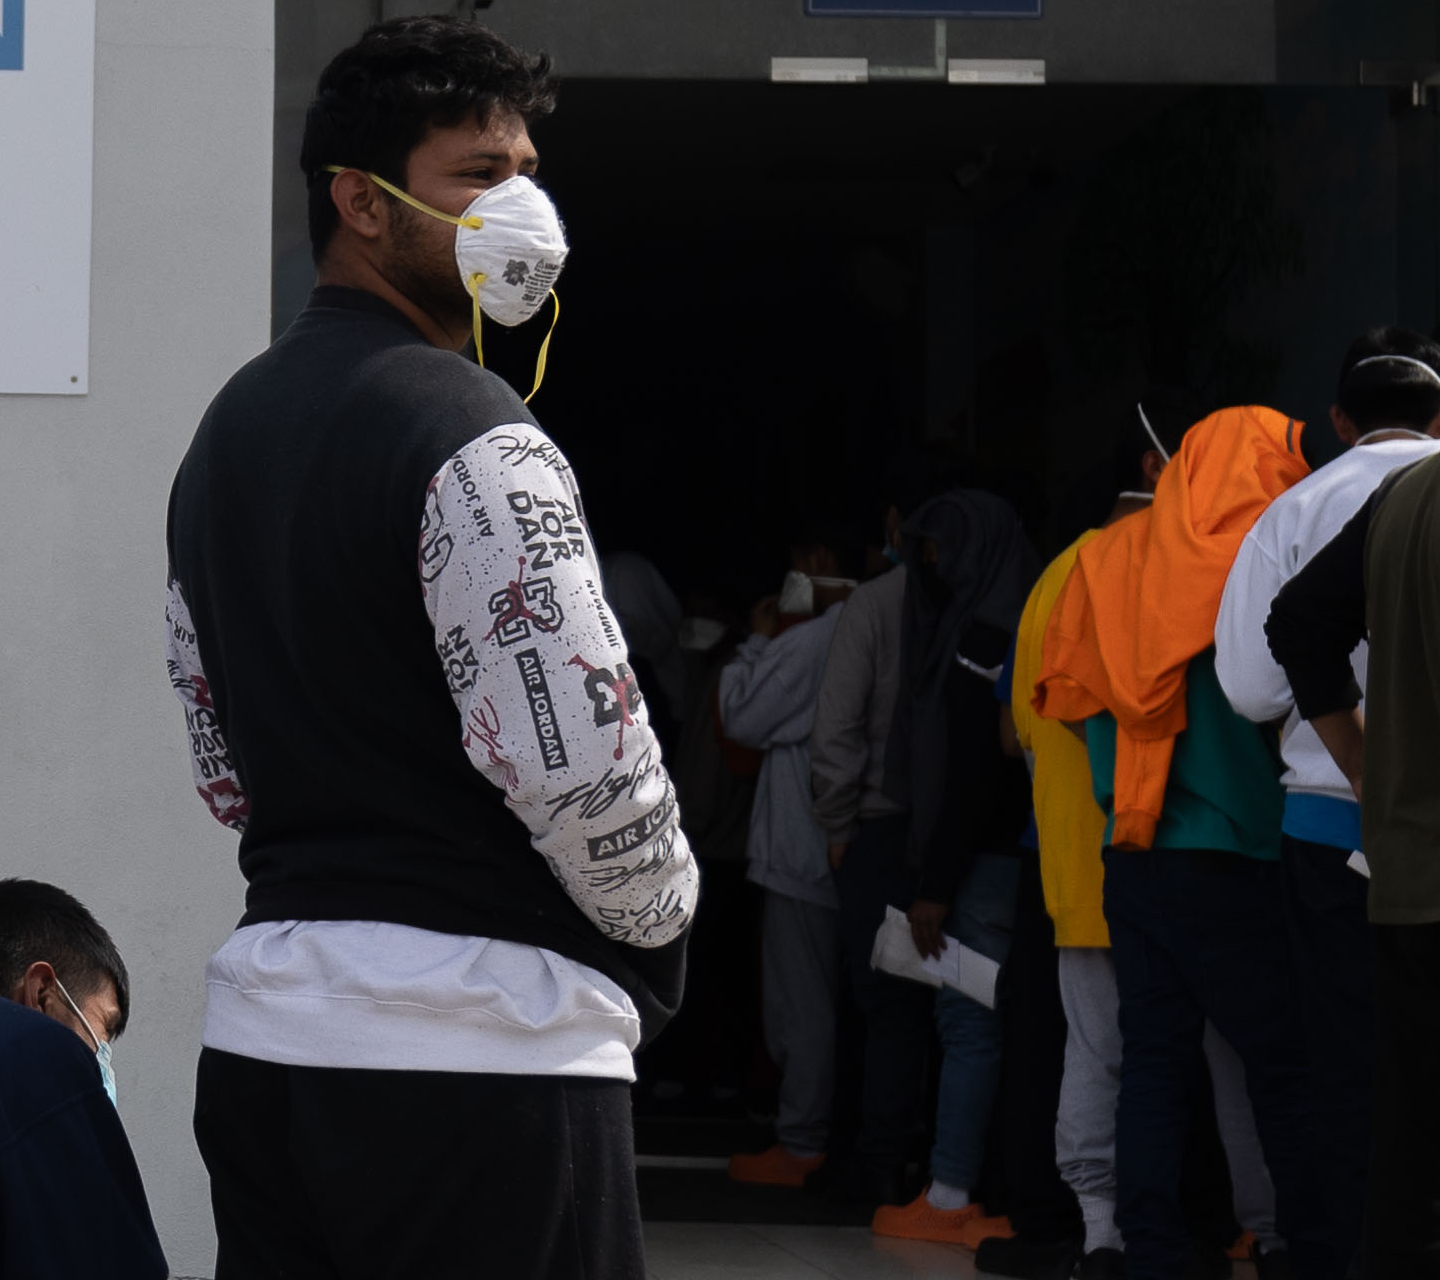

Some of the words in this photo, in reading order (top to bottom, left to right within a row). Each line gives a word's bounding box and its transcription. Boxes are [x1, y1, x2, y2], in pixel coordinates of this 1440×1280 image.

[472, 505, 495, 537] AIR
[505, 490, 554, 571] DAN
[532, 492, 572, 562] JOR
[554, 498, 585, 558] AIR
[520, 656, 542, 687] AIR
[531, 689, 564, 767] JORDAN
[596, 826, 640, 856] AIR
